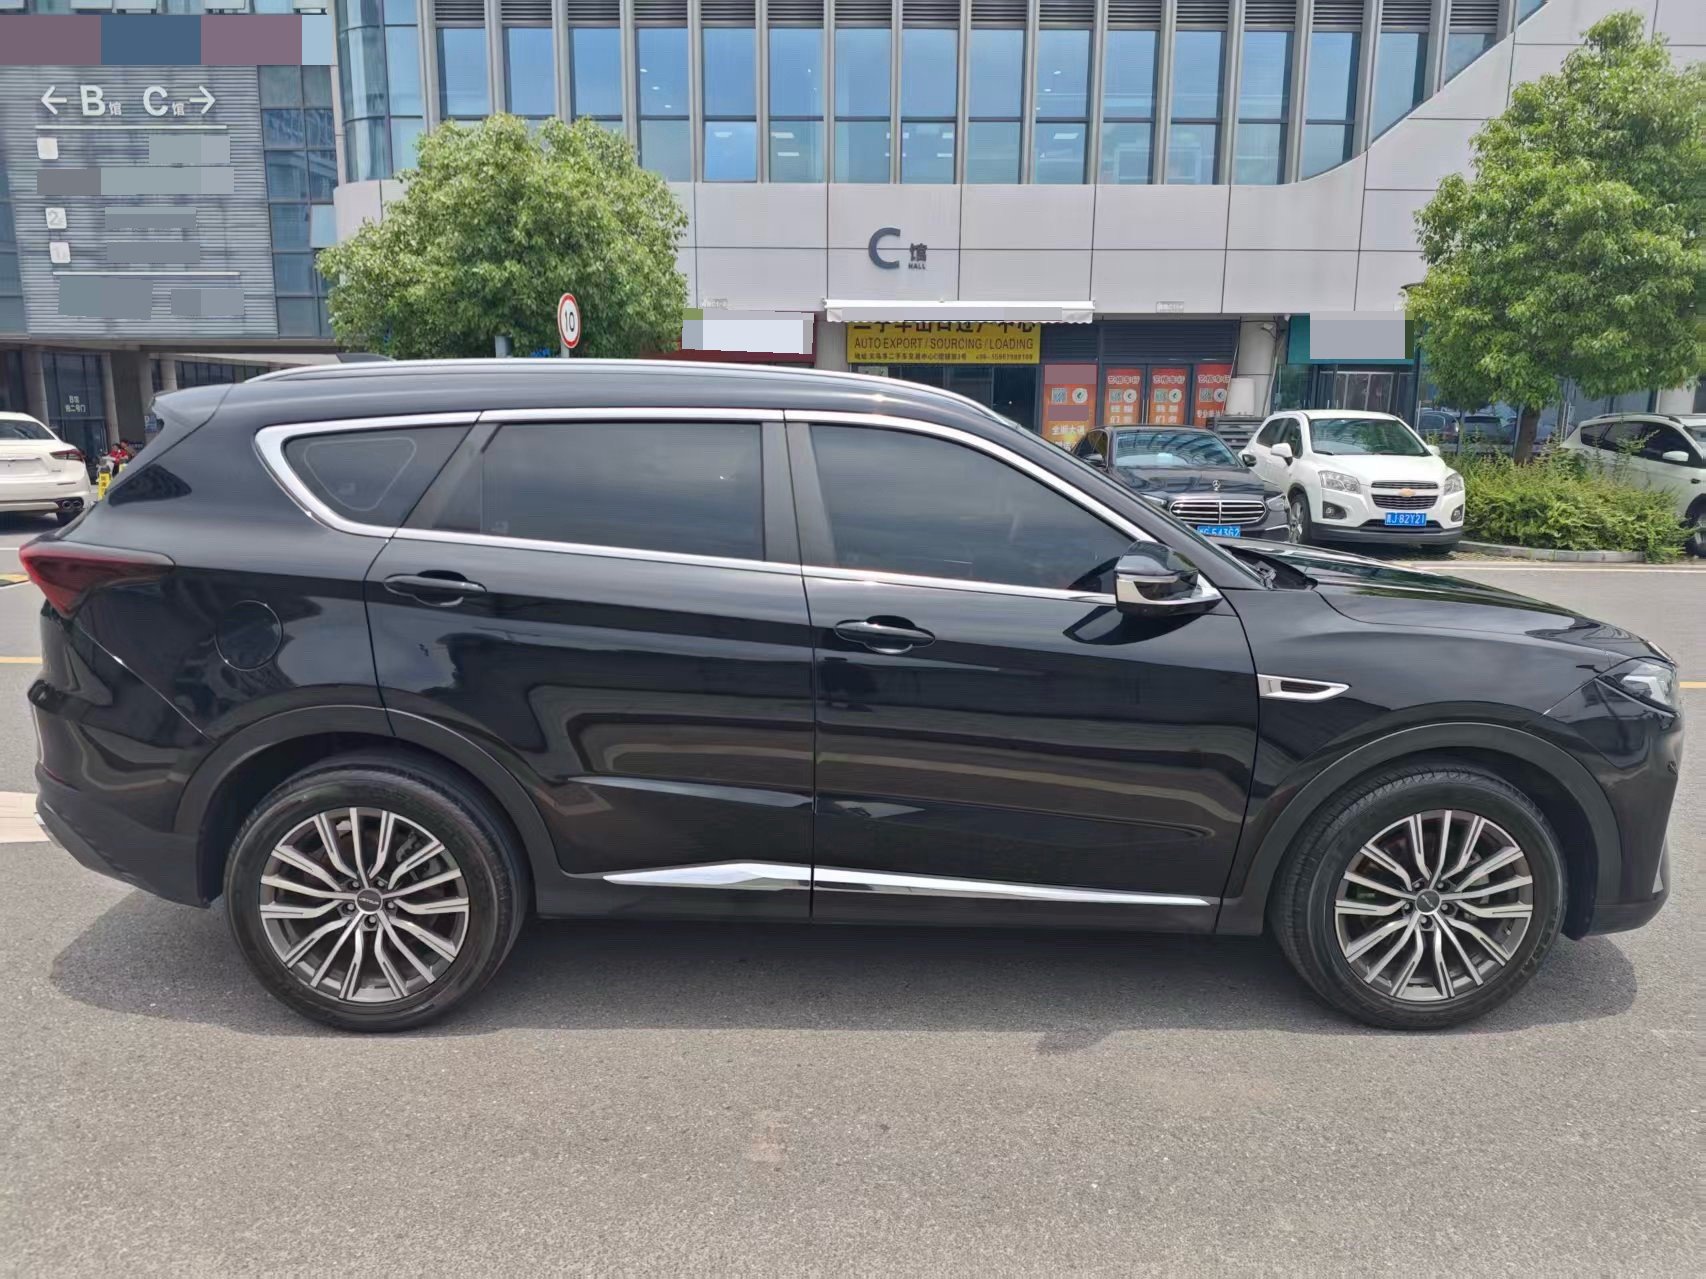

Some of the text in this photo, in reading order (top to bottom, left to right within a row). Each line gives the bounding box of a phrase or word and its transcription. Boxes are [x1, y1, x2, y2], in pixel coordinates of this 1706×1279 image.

[565, 310, 575, 332] 10
[855, 337, 881, 349] AUTO
[883, 337, 923, 349] EXPORT
[930, 338, 983, 350] SOURCING
[989, 338, 1034, 350] LOADING
